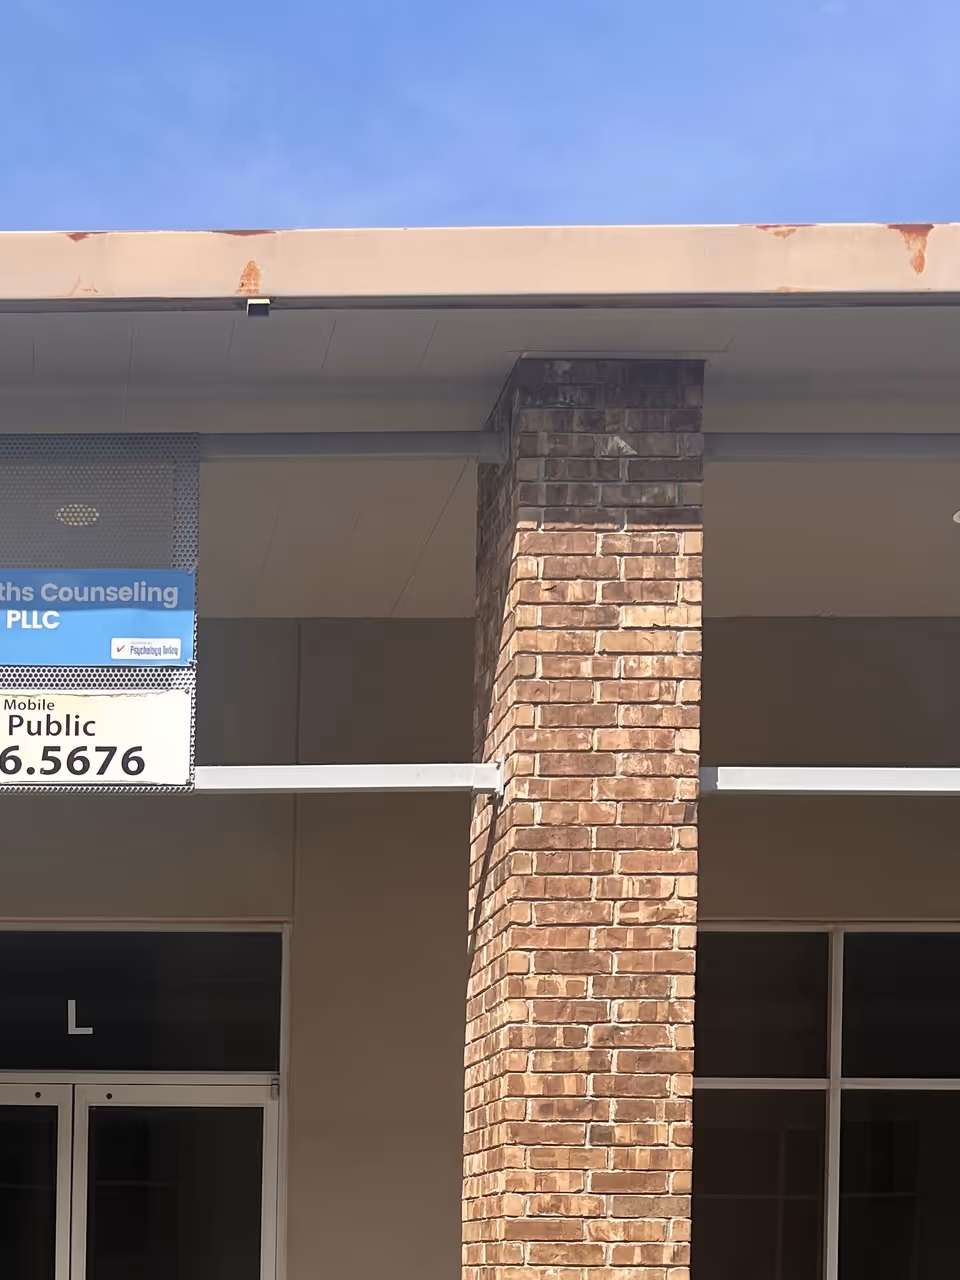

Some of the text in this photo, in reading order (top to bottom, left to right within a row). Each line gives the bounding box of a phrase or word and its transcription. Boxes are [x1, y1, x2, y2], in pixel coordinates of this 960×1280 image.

[40, 582, 179, 608] Counseling
[6, 610, 60, 629] PLLC
[4, 699, 55, 711] Mobile
[8, 714, 96, 737] Public
[67, 999, 94, 1035] L
